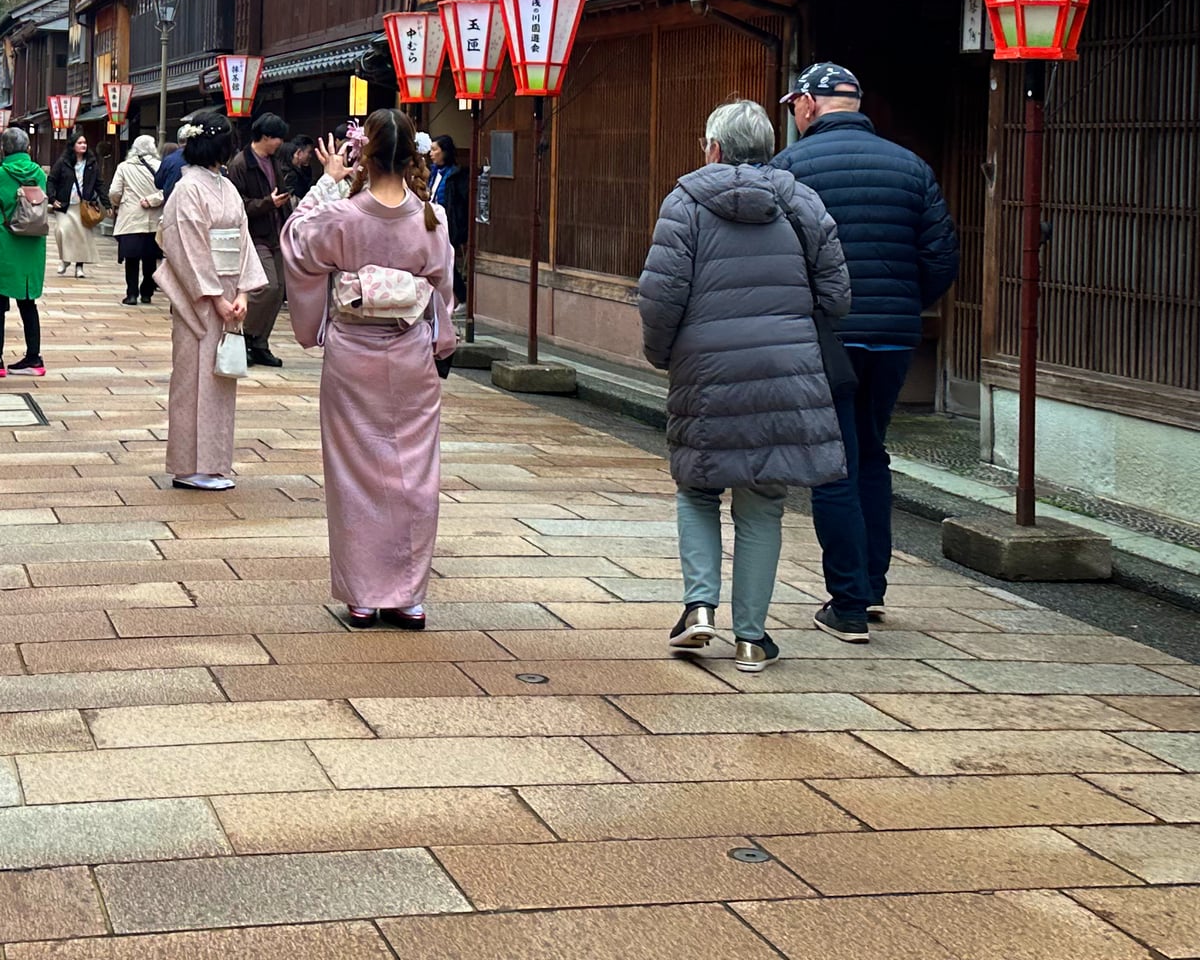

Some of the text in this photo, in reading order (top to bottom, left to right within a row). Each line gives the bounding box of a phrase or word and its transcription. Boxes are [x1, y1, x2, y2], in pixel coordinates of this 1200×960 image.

[406, 28, 417, 63] 中むら
[467, 17, 480, 52] 玉匣
